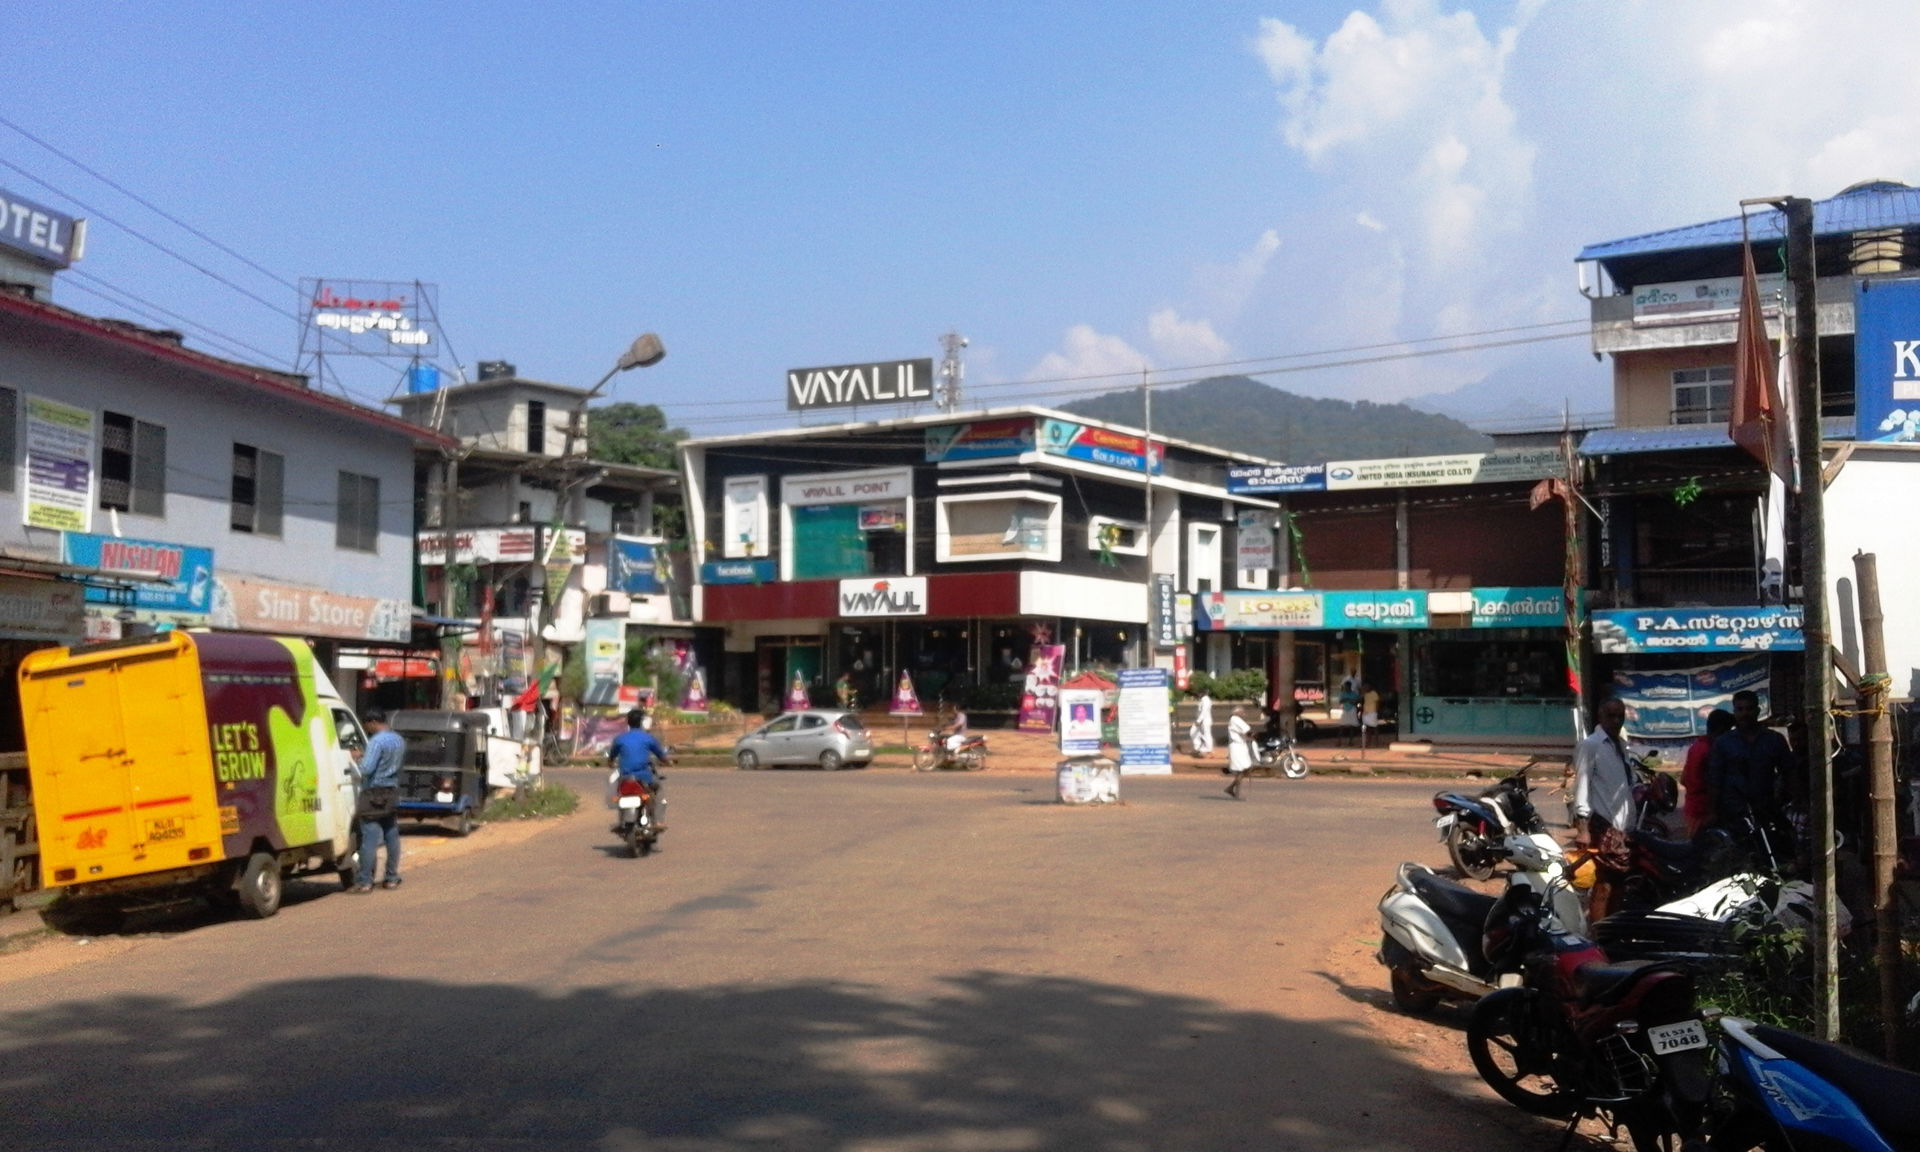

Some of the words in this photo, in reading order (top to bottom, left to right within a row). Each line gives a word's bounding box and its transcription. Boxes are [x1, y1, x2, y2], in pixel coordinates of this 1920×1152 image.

[789, 364, 930, 406] VAYALIL
[1355, 471, 1382, 482] UNITED
[1384, 470, 1403, 480] INDIA
[1405, 468, 1445, 479] INSURANCE
[801, 484, 845, 498] VAYALIL
[853, 482, 891, 494] POINT
[102, 542, 182, 578] NISHAN
[257, 588, 300, 622] Sini
[308, 595, 365, 629] Store
[842, 592, 921, 612] VAYALIL
[213, 722, 260, 750] LET'S
[217, 751, 266, 782] GROW
[1659, 1034, 1700, 1050] 7048
